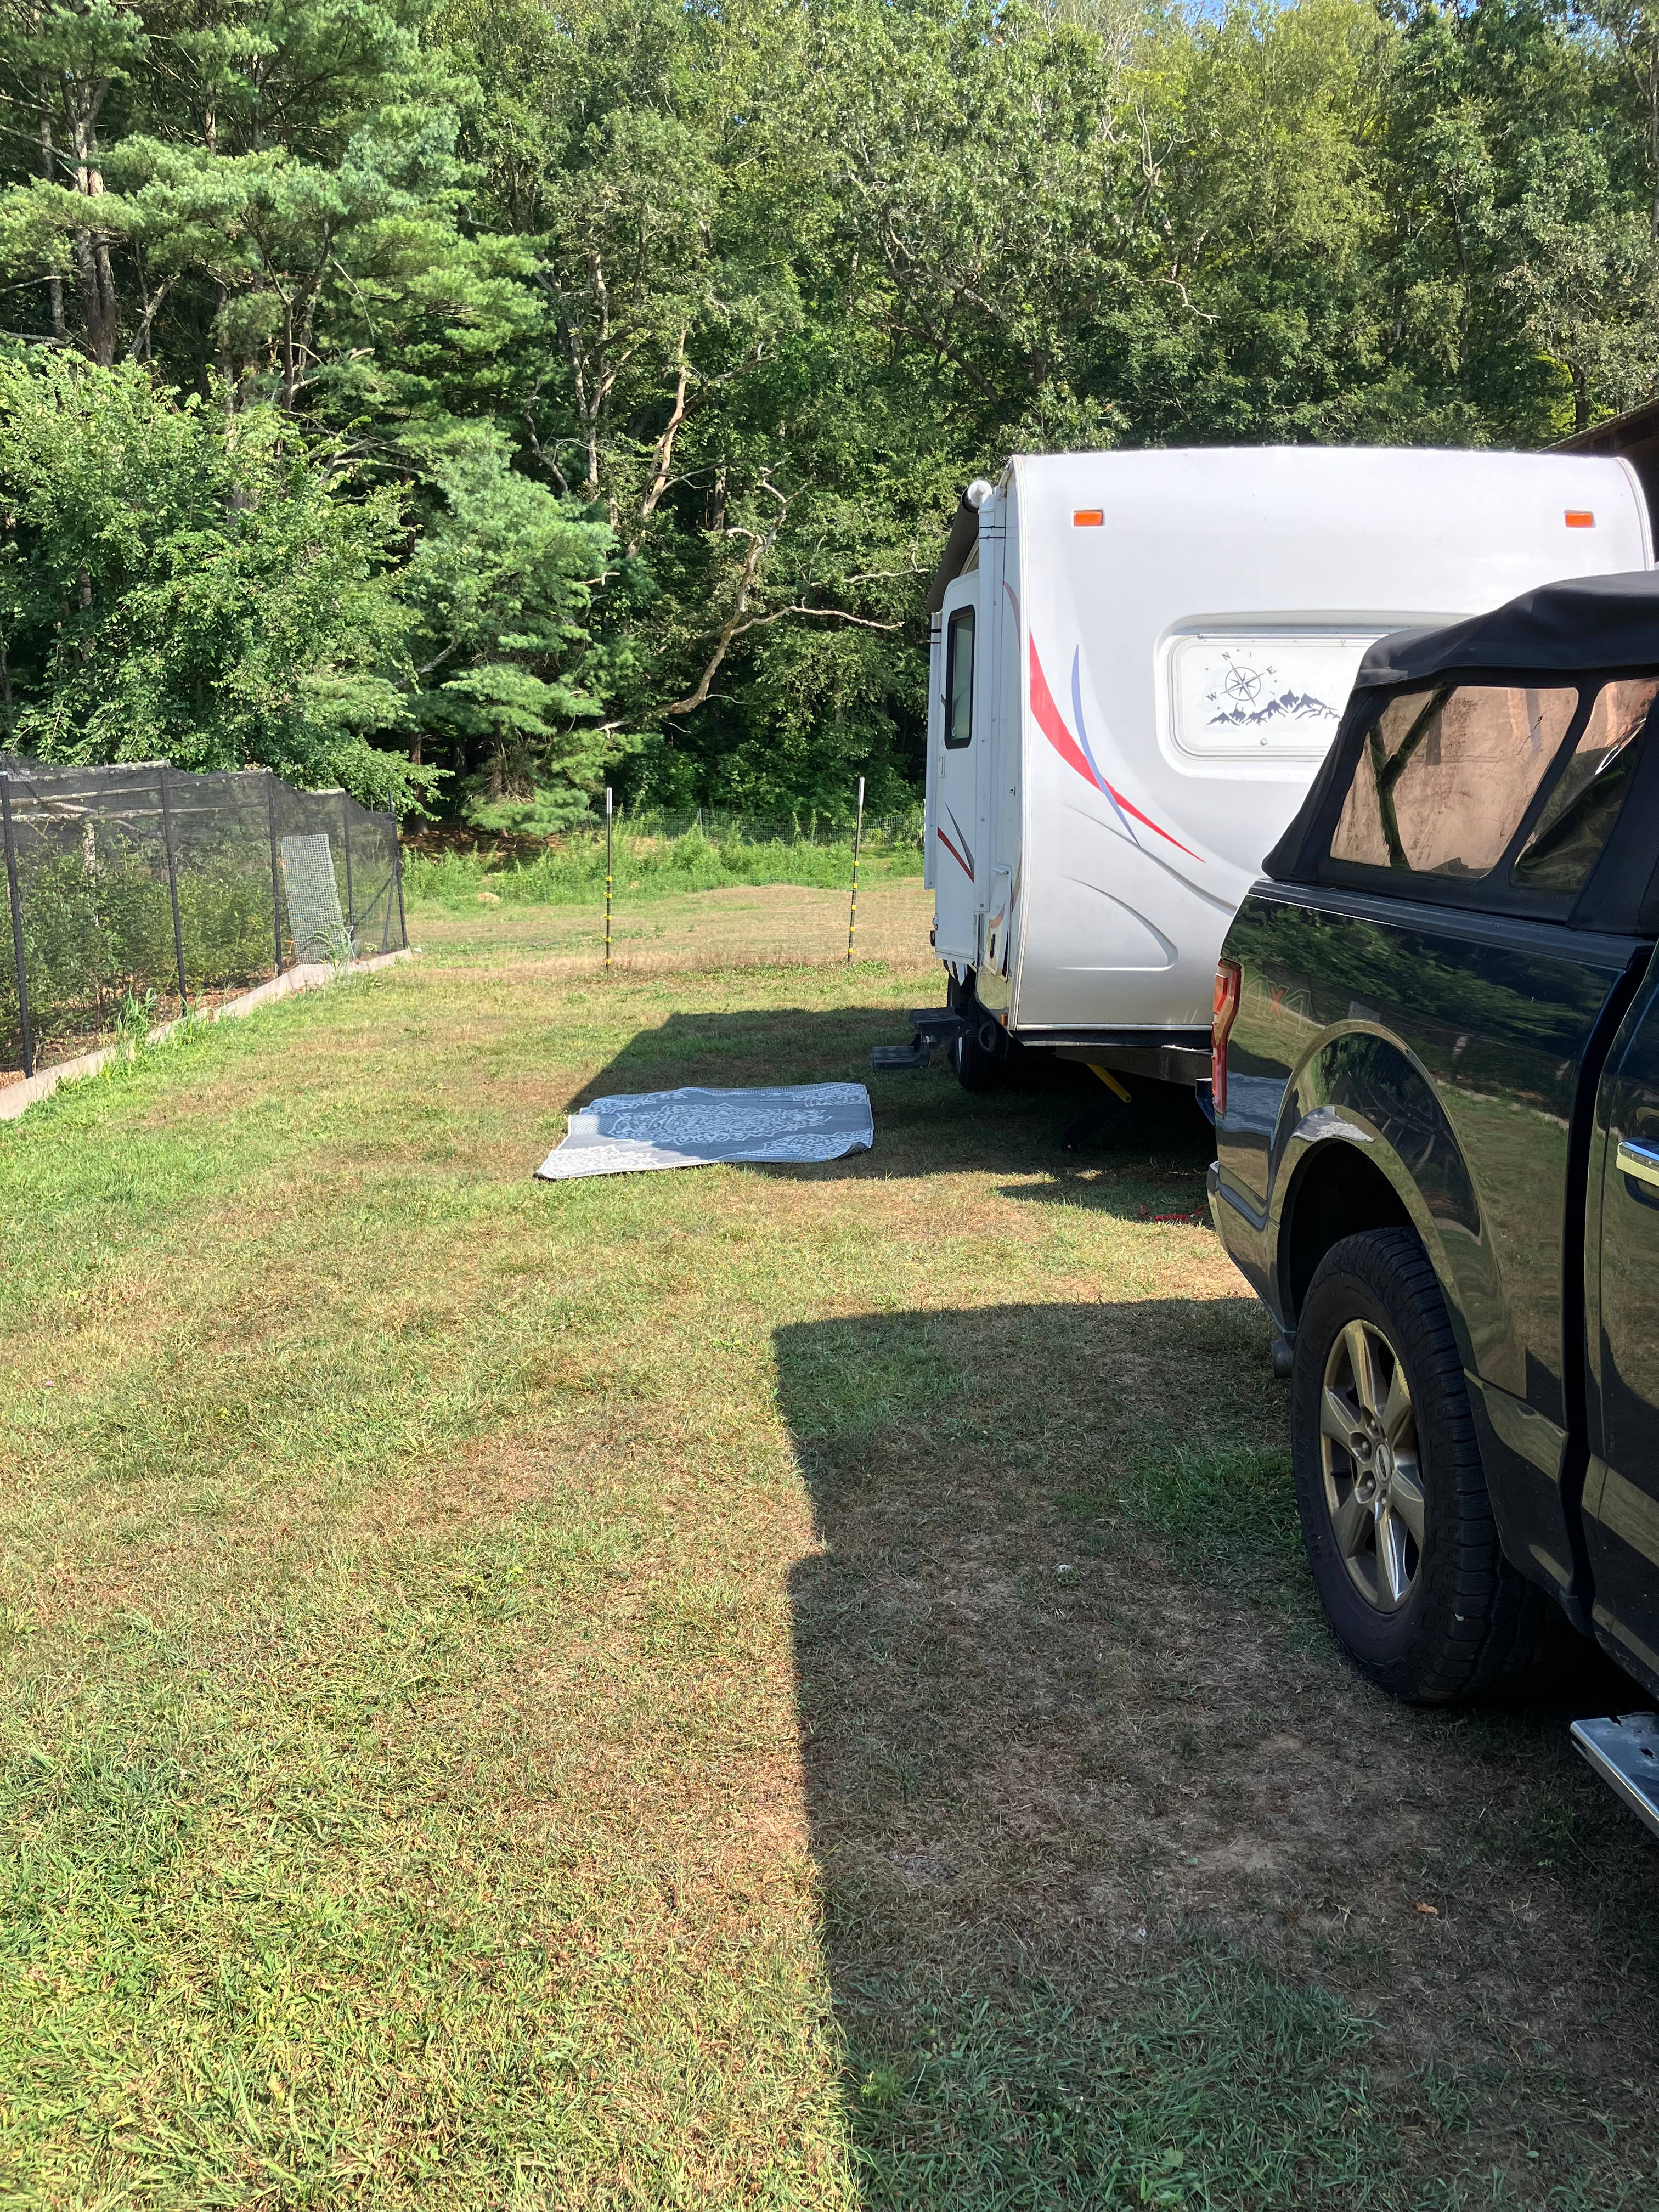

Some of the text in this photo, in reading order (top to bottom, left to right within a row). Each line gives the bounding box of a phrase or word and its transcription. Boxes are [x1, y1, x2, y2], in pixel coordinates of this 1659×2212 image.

[1222, 652, 1231, 661] N
[1266, 665, 1277, 675] E
[1206, 692, 1217, 702] W
